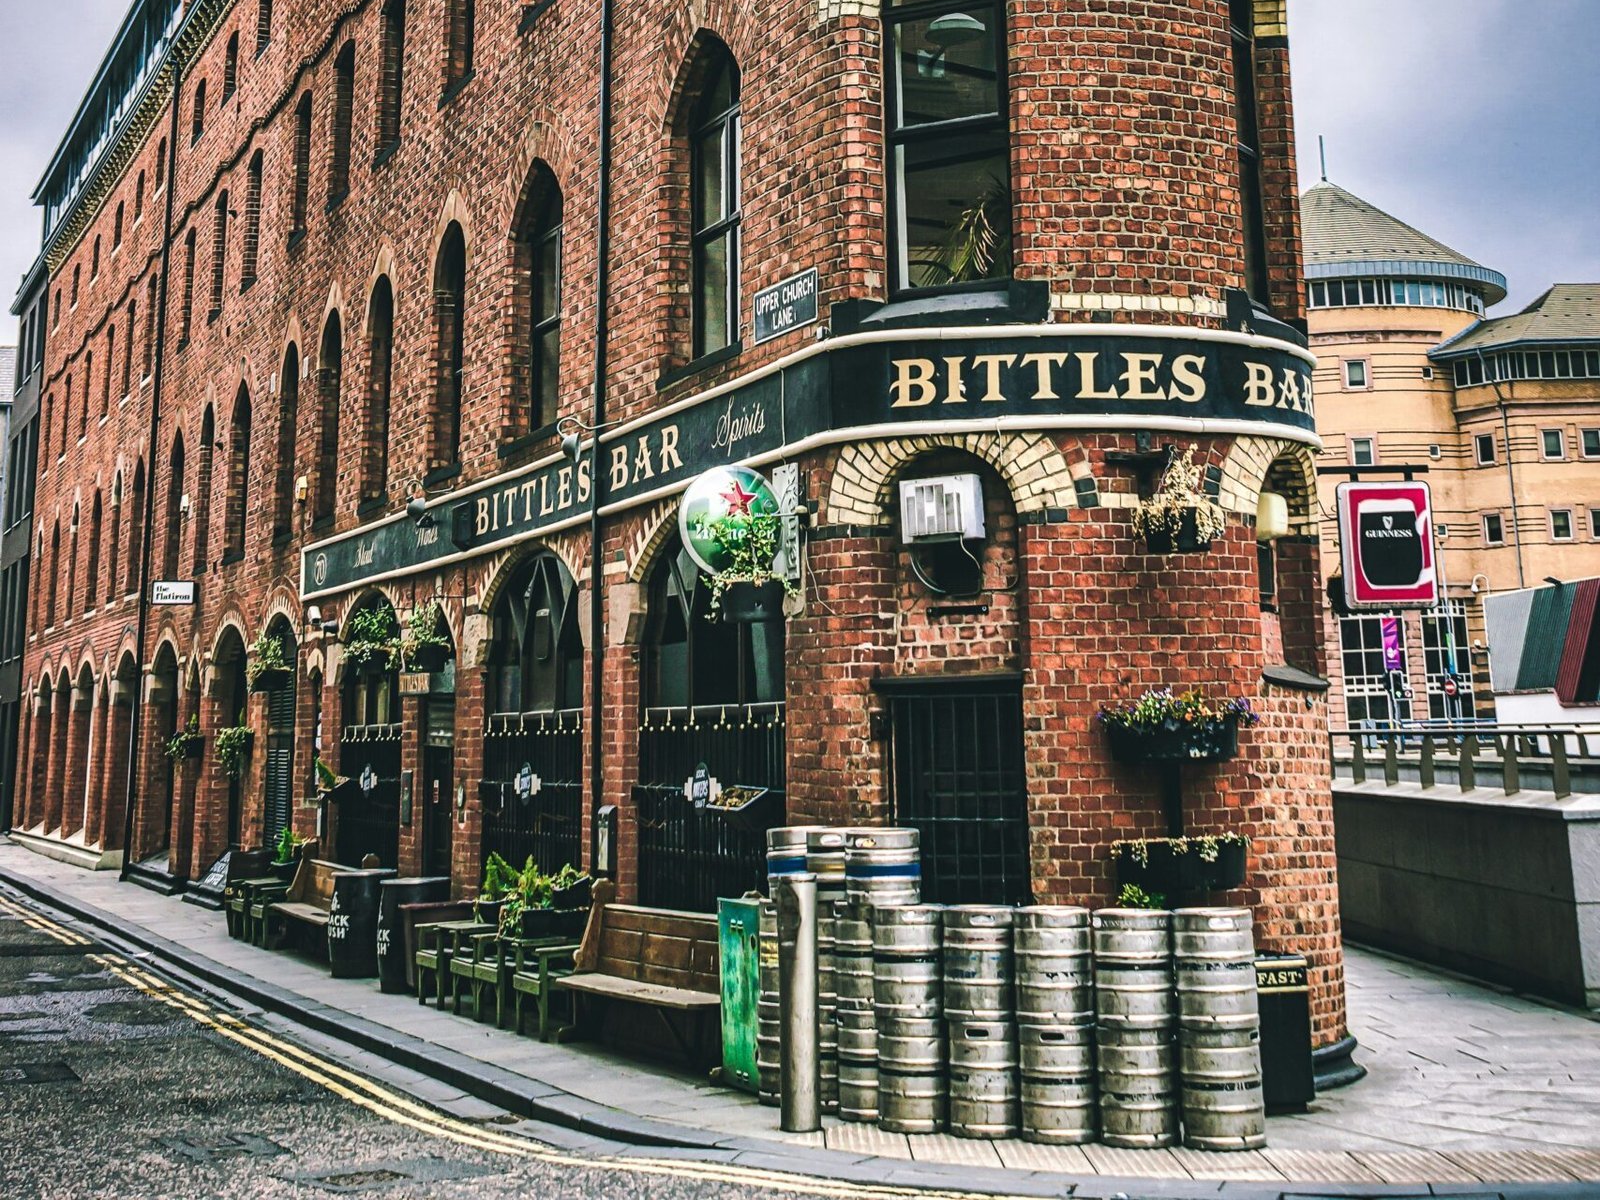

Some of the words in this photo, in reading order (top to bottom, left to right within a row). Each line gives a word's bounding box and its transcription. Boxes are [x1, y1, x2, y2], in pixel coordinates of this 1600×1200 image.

[756, 291, 779, 316] UPPER
[782, 275, 814, 304] CHURCH
[772, 305, 793, 330] LANE
[890, 351, 1206, 408] BITTLES
[1243, 361, 1315, 418] BAR
[475, 457, 592, 537] BITTLES
[609, 424, 683, 492] BAR
[711, 395, 766, 456] Spirits
[1365, 529, 1413, 538] GUINNESS
